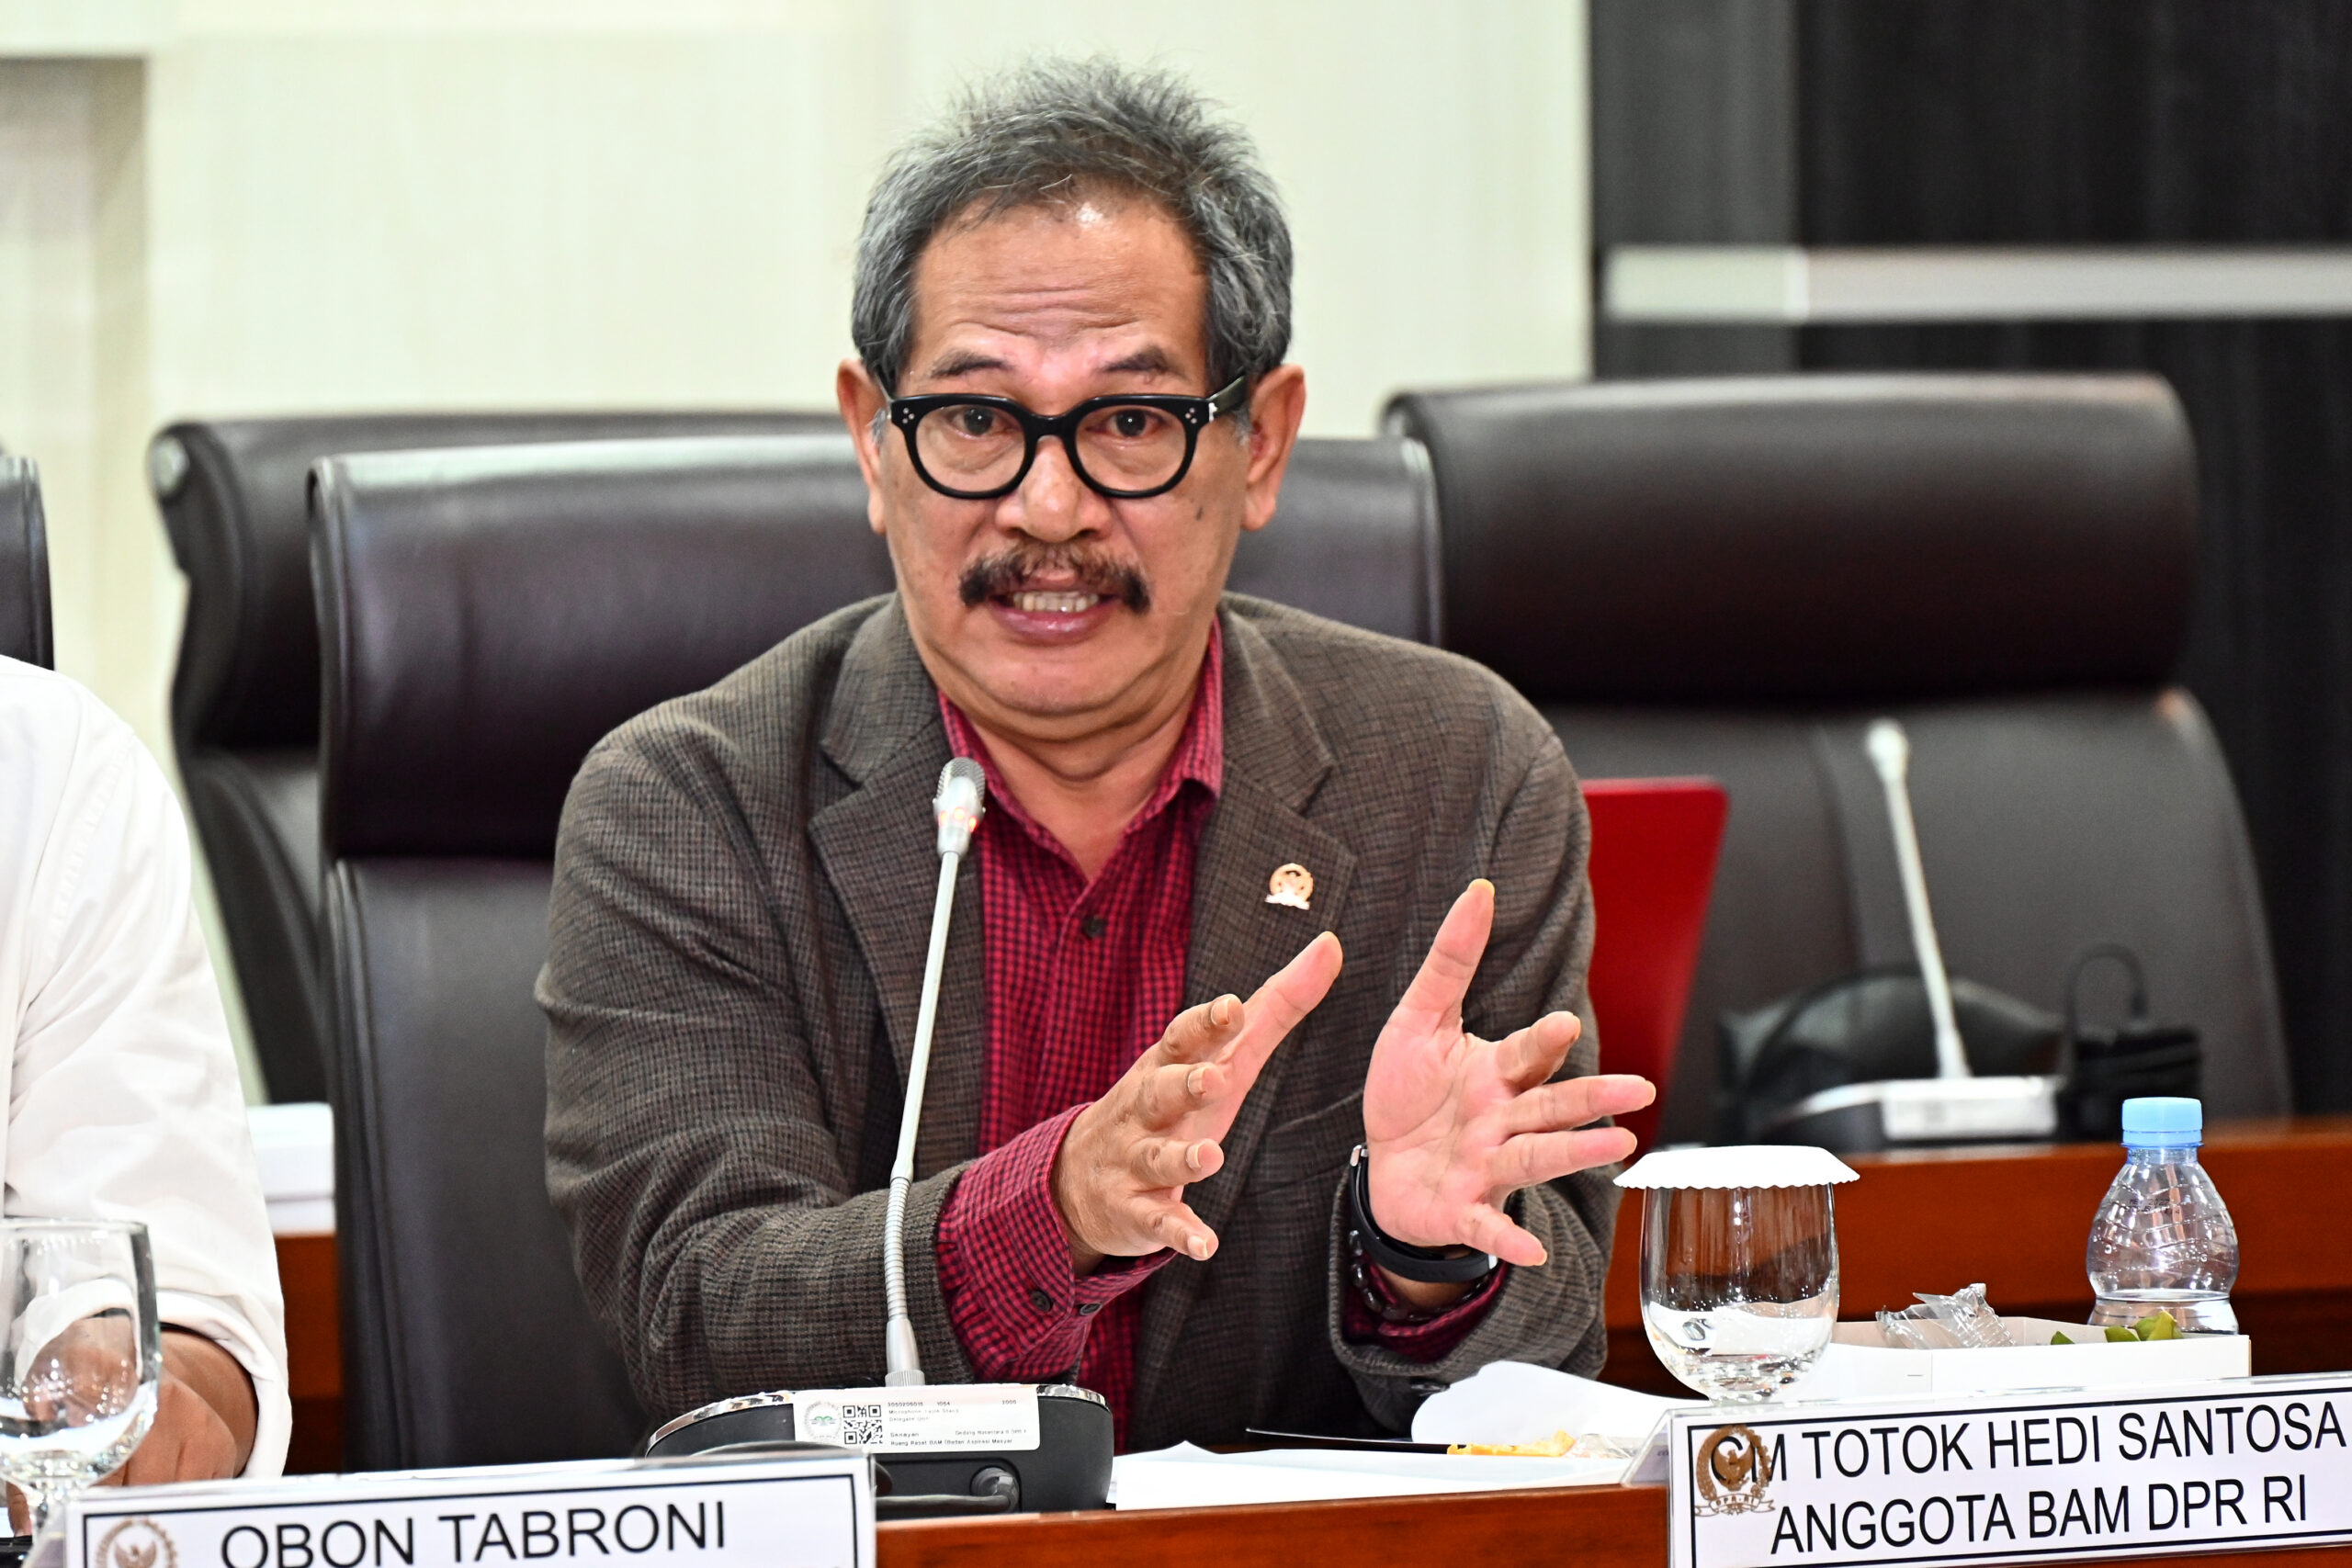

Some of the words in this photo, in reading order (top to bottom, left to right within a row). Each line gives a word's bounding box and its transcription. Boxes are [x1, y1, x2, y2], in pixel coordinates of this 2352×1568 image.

[1802, 1422, 1973, 1479] TOTOK
[1987, 1415, 2100, 1469] HEDI
[2119, 1402, 2347, 1461] SANTOSA
[221, 1517, 413, 1568] OBON
[438, 1502, 724, 1562] TABRONI
[1771, 1494, 2016, 1555] ANGGOTA
[2029, 1485, 2130, 1539] BAM
[2148, 1479, 2247, 1531] DPR
[2263, 1473, 2306, 1523] RI
